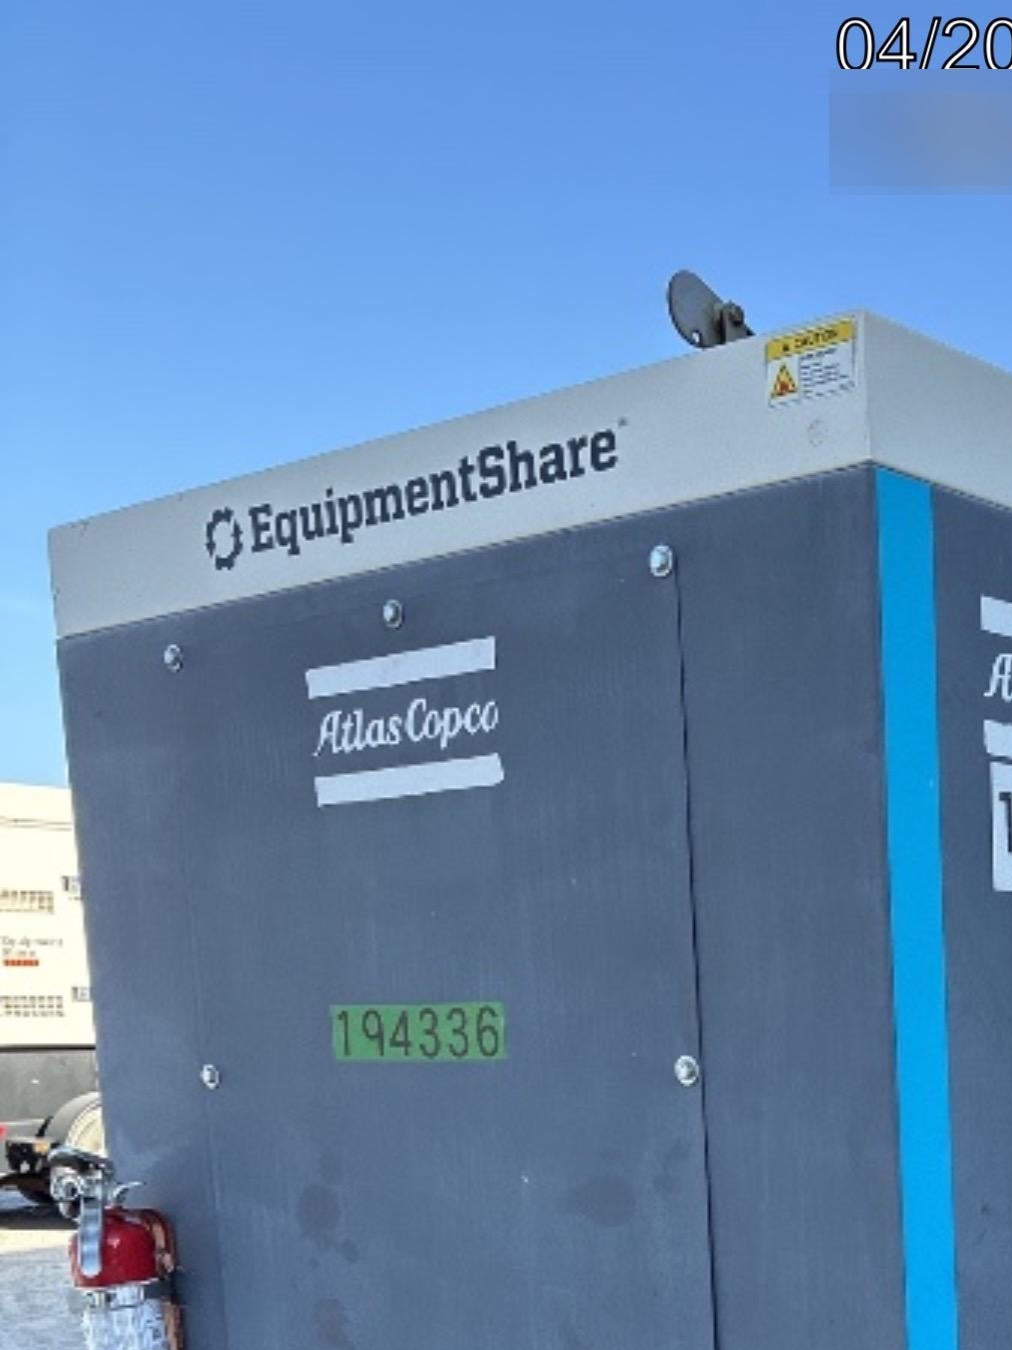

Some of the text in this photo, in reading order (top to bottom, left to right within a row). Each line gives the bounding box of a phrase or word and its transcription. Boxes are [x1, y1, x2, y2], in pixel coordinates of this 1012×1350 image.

[248, 427, 619, 557] EquipmentShare
[312, 697, 499, 757] Atlas Copco
[336, 1006, 500, 1059] 194336
